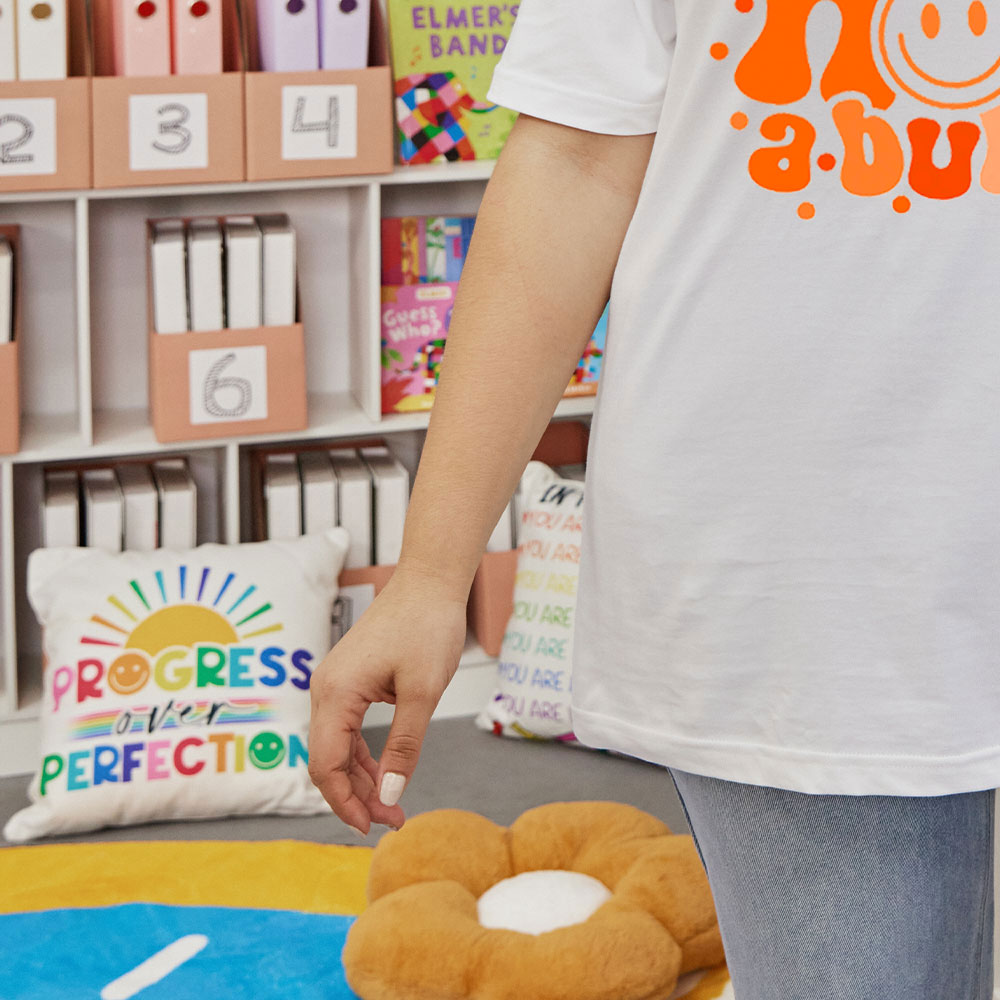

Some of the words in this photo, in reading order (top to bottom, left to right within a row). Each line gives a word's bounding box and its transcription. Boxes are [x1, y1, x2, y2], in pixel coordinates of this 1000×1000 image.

[429, 33, 508, 59] BAND
[0, 112, 35, 164] 2
[152, 101, 193, 156] 3
[290, 95, 340, 149] 4
[748, 112, 817, 193] a
[383, 306, 437, 328] Guess
[388, 319, 442, 343] Who?
[203, 352, 253, 418] 6
[52, 646, 313, 713] PROGRESS
[115, 699, 240, 735] over
